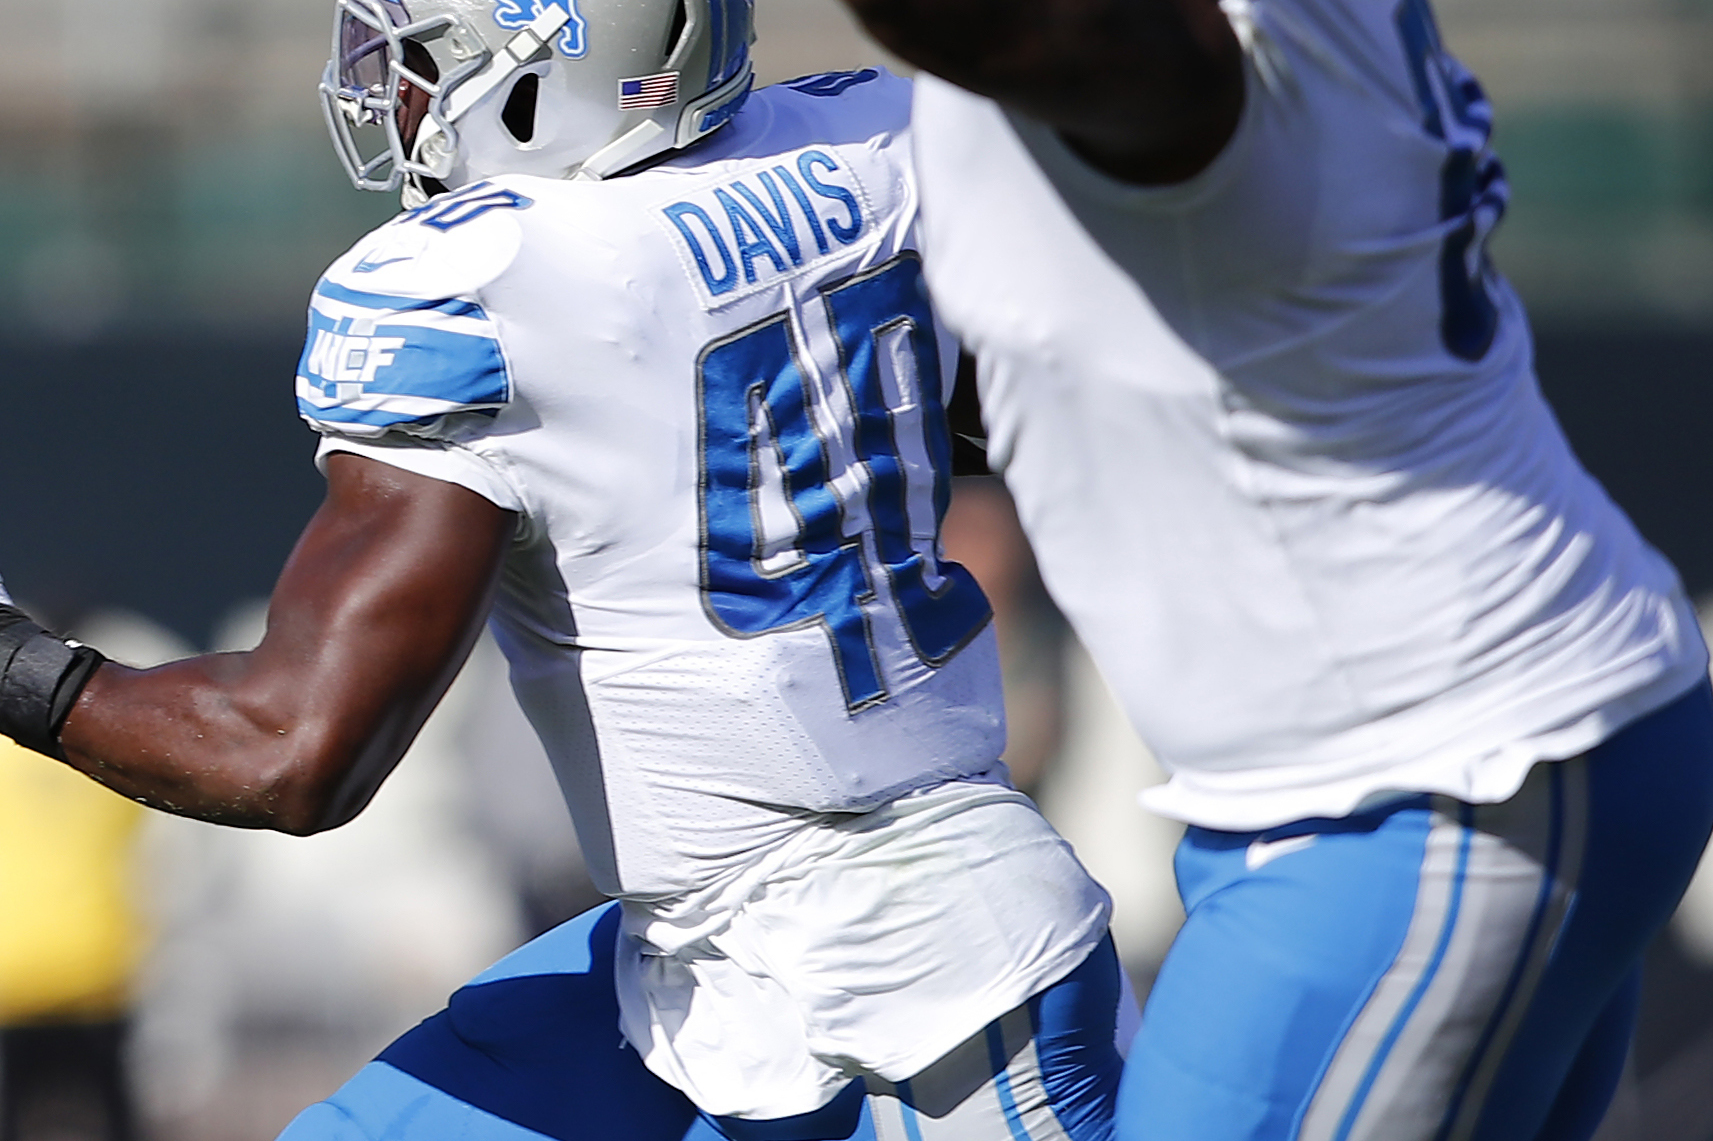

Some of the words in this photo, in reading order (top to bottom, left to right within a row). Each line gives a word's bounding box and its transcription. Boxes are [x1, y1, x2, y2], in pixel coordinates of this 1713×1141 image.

[662, 150, 862, 296] DAVIS
[308, 329, 406, 382] WCF
[695, 248, 994, 717] 40
